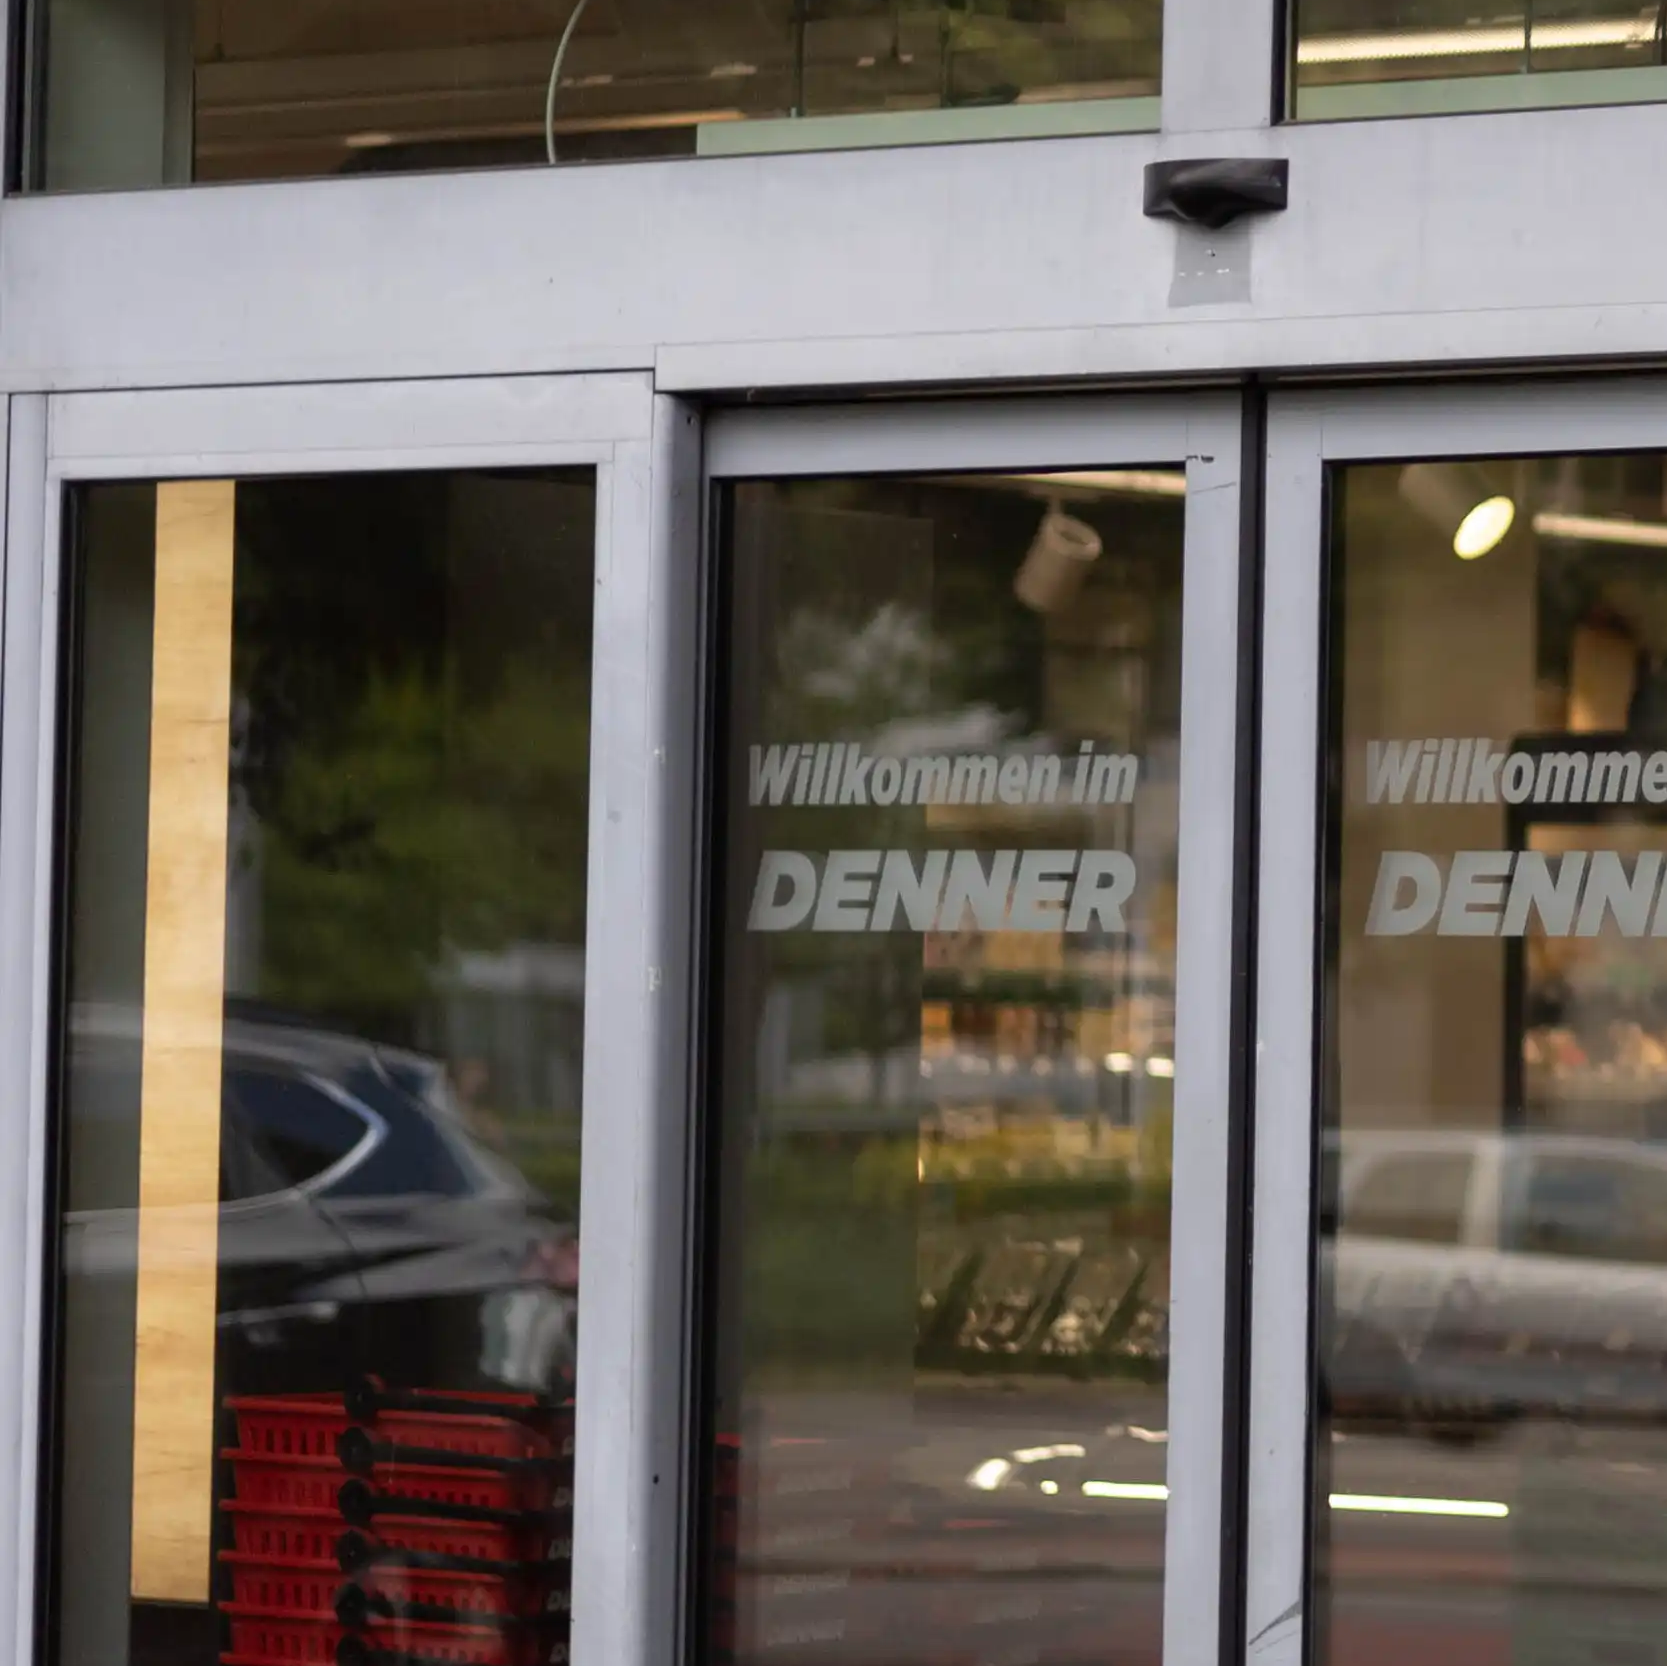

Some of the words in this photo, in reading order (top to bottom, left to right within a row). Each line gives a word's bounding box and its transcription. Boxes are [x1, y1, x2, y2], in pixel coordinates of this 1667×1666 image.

[749, 742, 1061, 806] Willkommen
[1073, 739, 1138, 803] im
[747, 849, 1137, 933] DENNER
